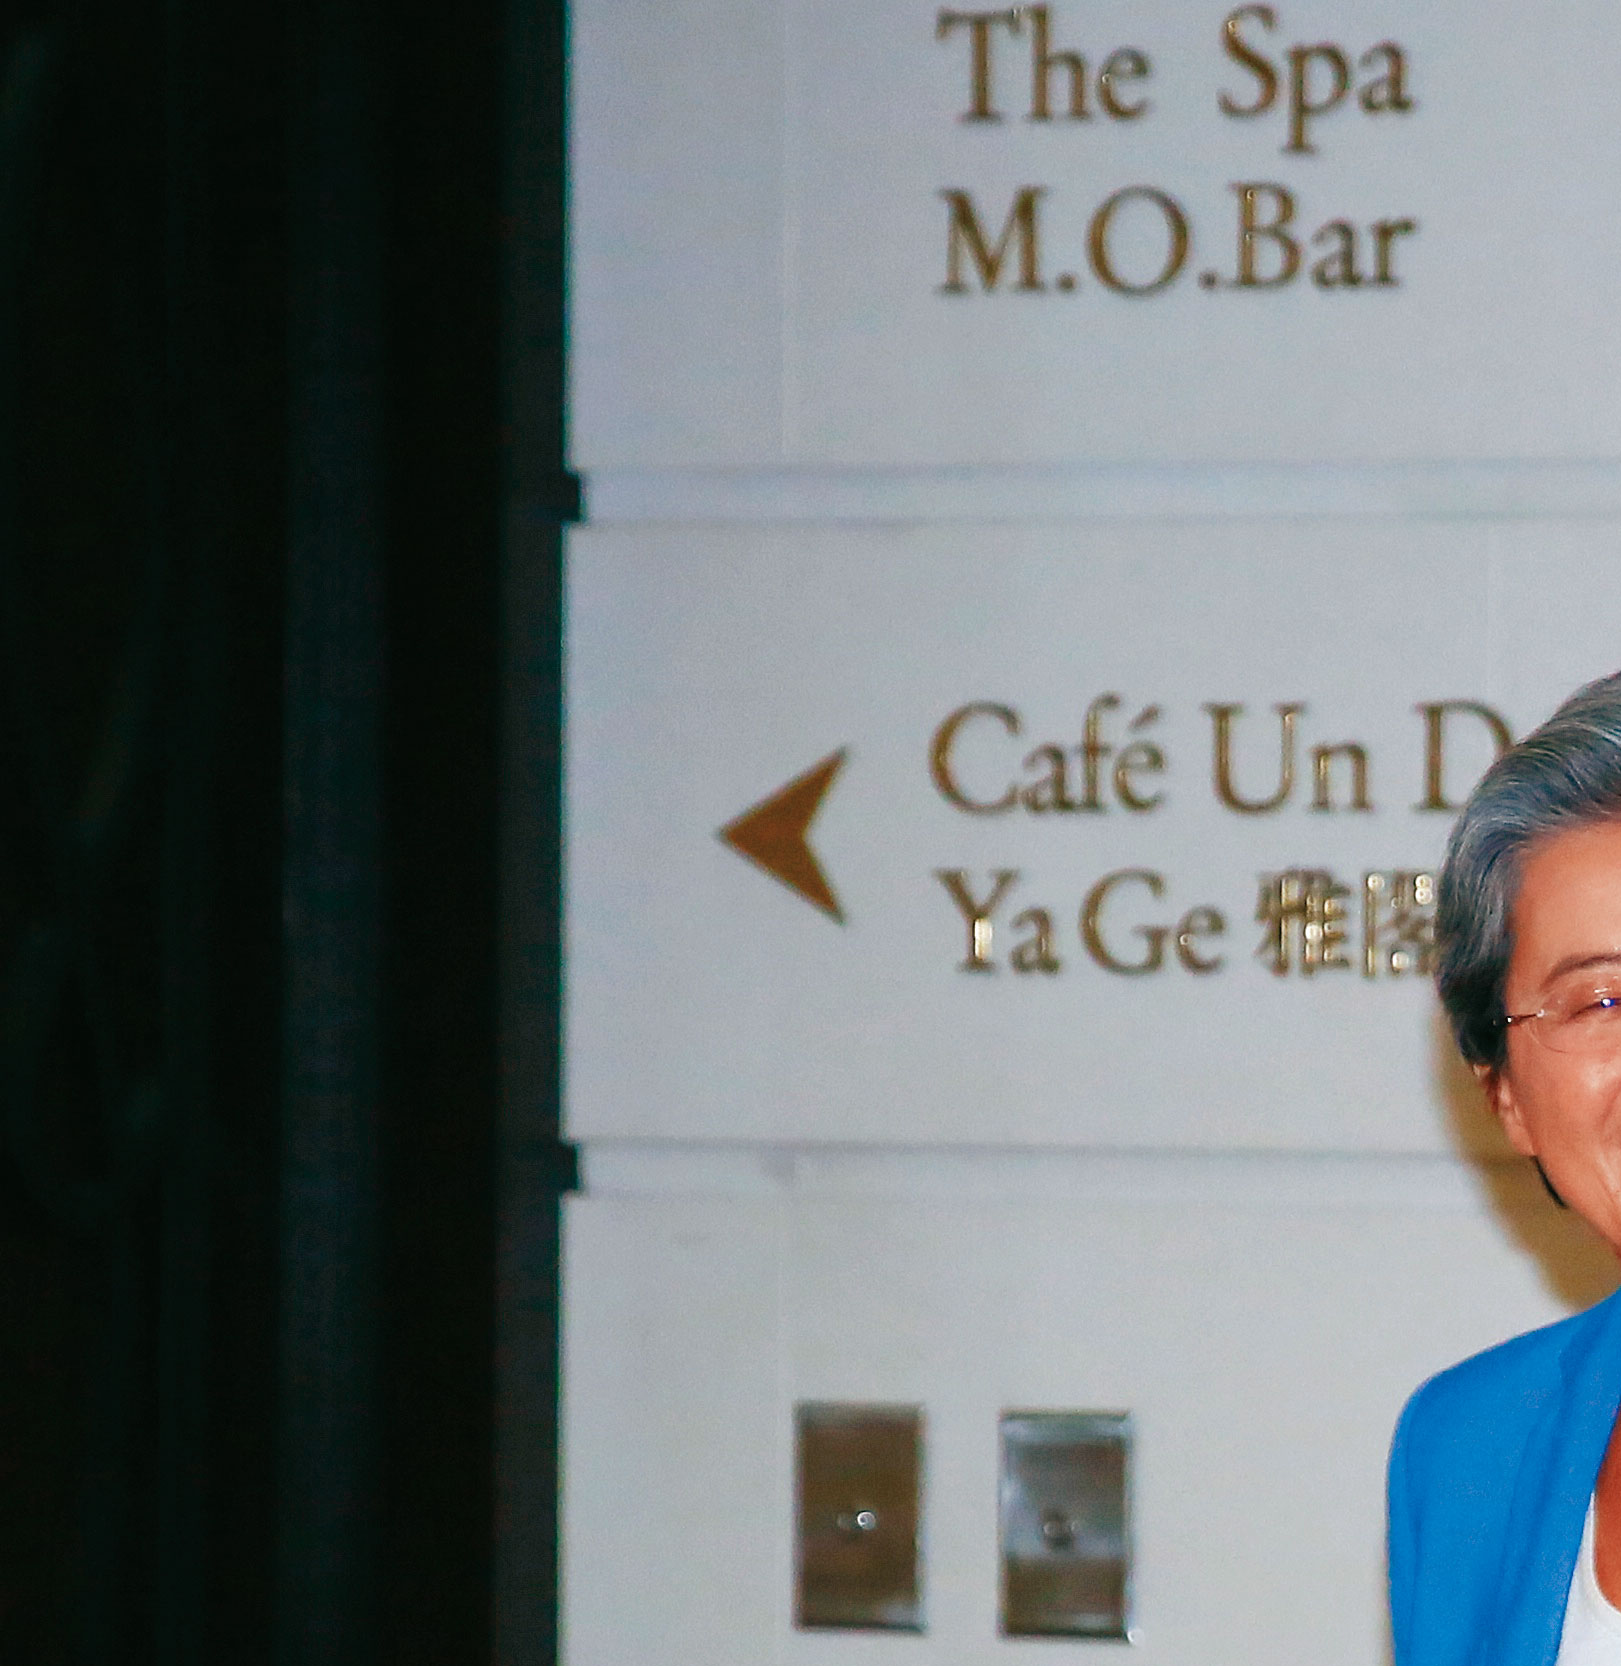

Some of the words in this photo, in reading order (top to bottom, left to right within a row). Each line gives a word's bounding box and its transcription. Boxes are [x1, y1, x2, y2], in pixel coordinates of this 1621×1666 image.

[936, 3, 1154, 124] The
[1216, 2, 1417, 156] Spa
[928, 692, 1166, 816] Café
[1203, 701, 1374, 815] Un
